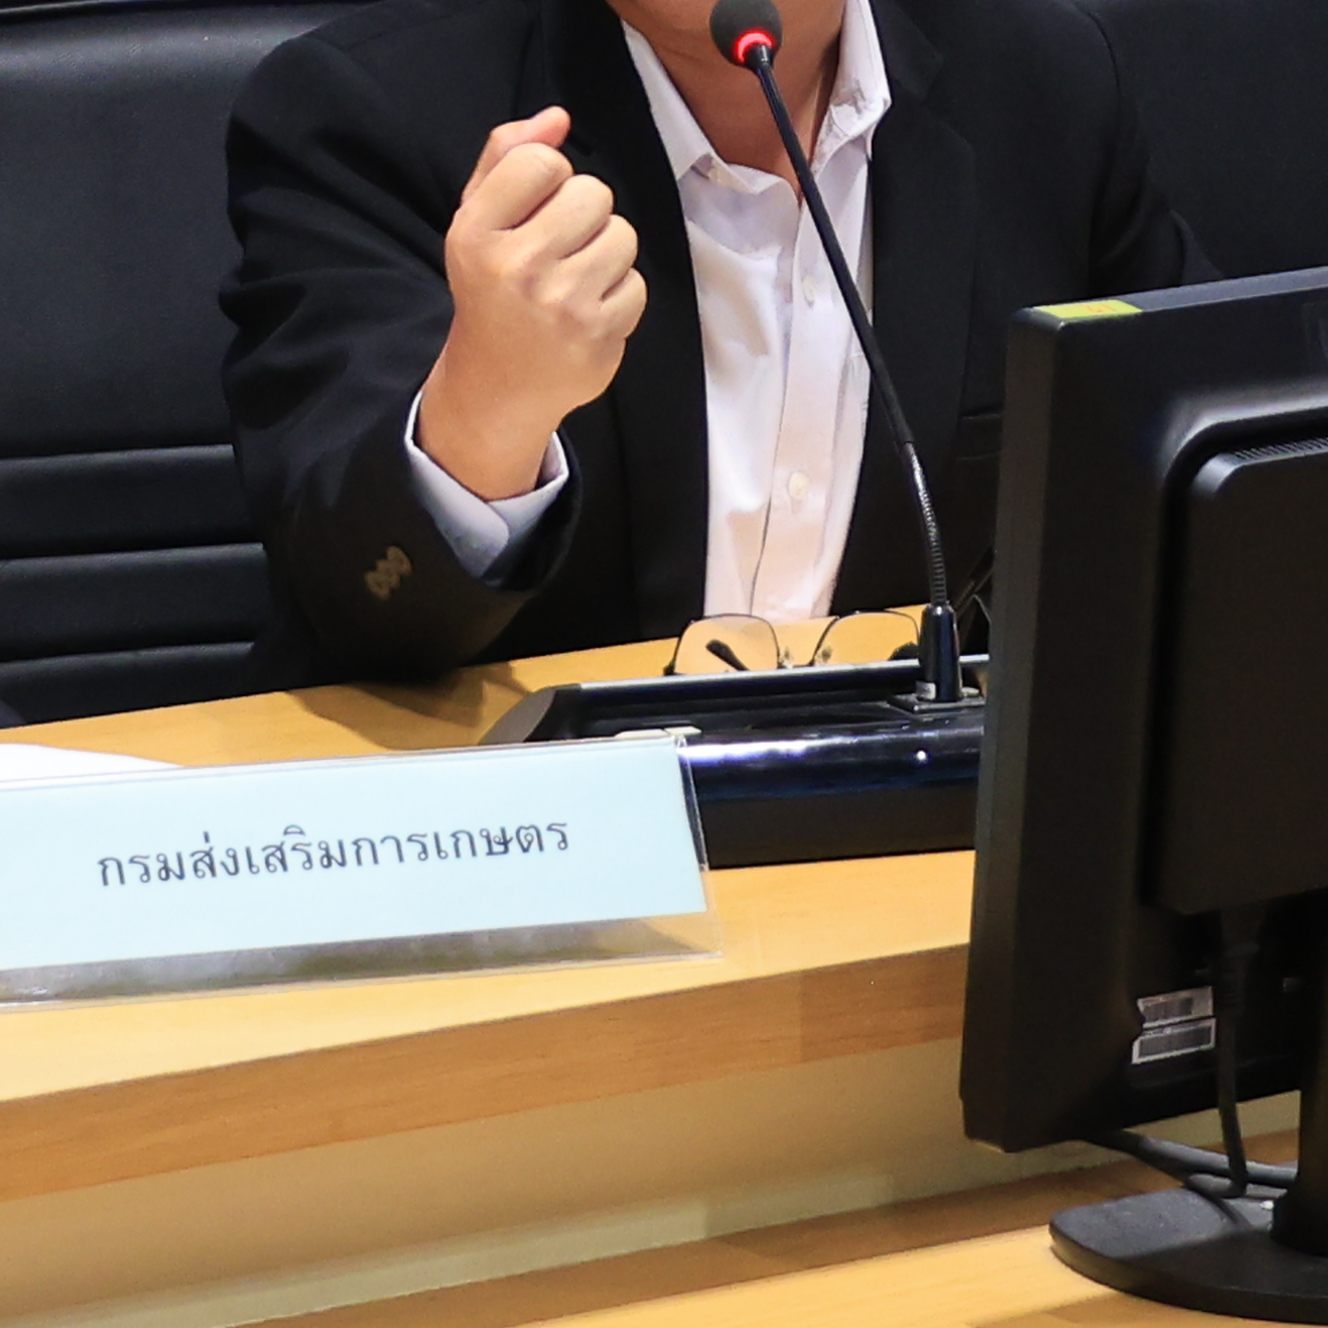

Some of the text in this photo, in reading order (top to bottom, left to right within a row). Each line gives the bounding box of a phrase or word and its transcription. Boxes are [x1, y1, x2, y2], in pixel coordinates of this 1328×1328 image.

[97, 821, 569, 887] กรมส่งเสริมการเกษตร
